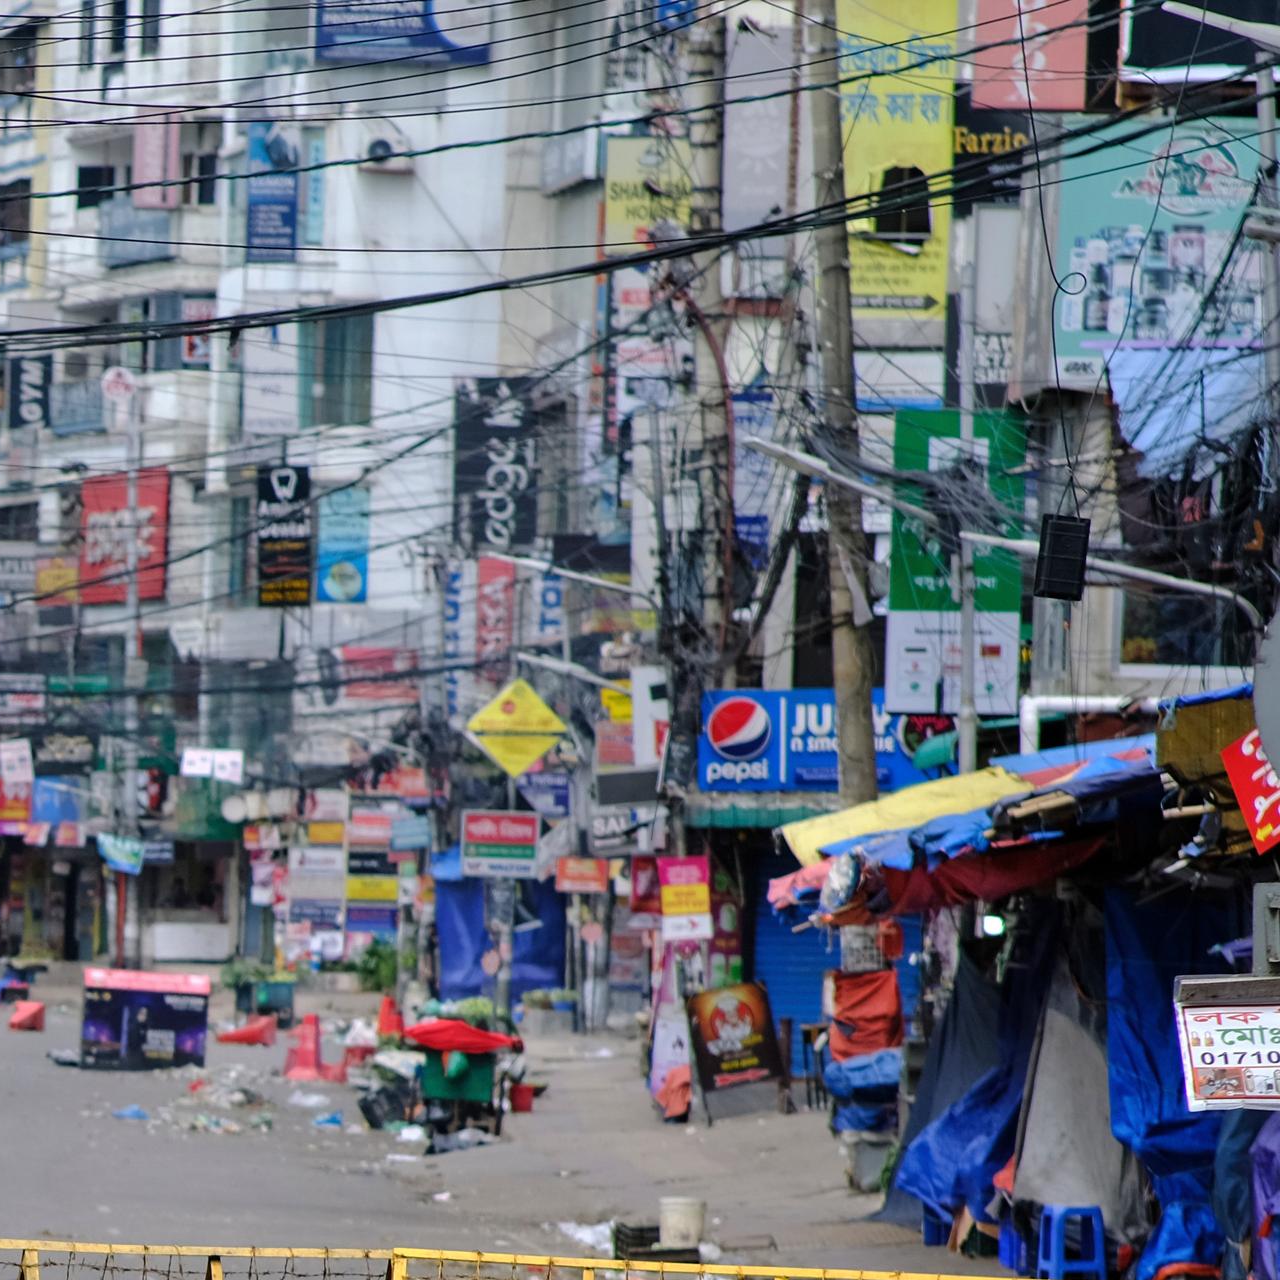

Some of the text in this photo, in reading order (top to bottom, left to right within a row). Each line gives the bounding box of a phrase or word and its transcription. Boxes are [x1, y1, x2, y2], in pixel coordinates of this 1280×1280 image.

[706, 757, 770, 784] pepsi
[1188, 1011, 1265, 1026] লক
[1199, 1050, 1280, 1066] 01710
